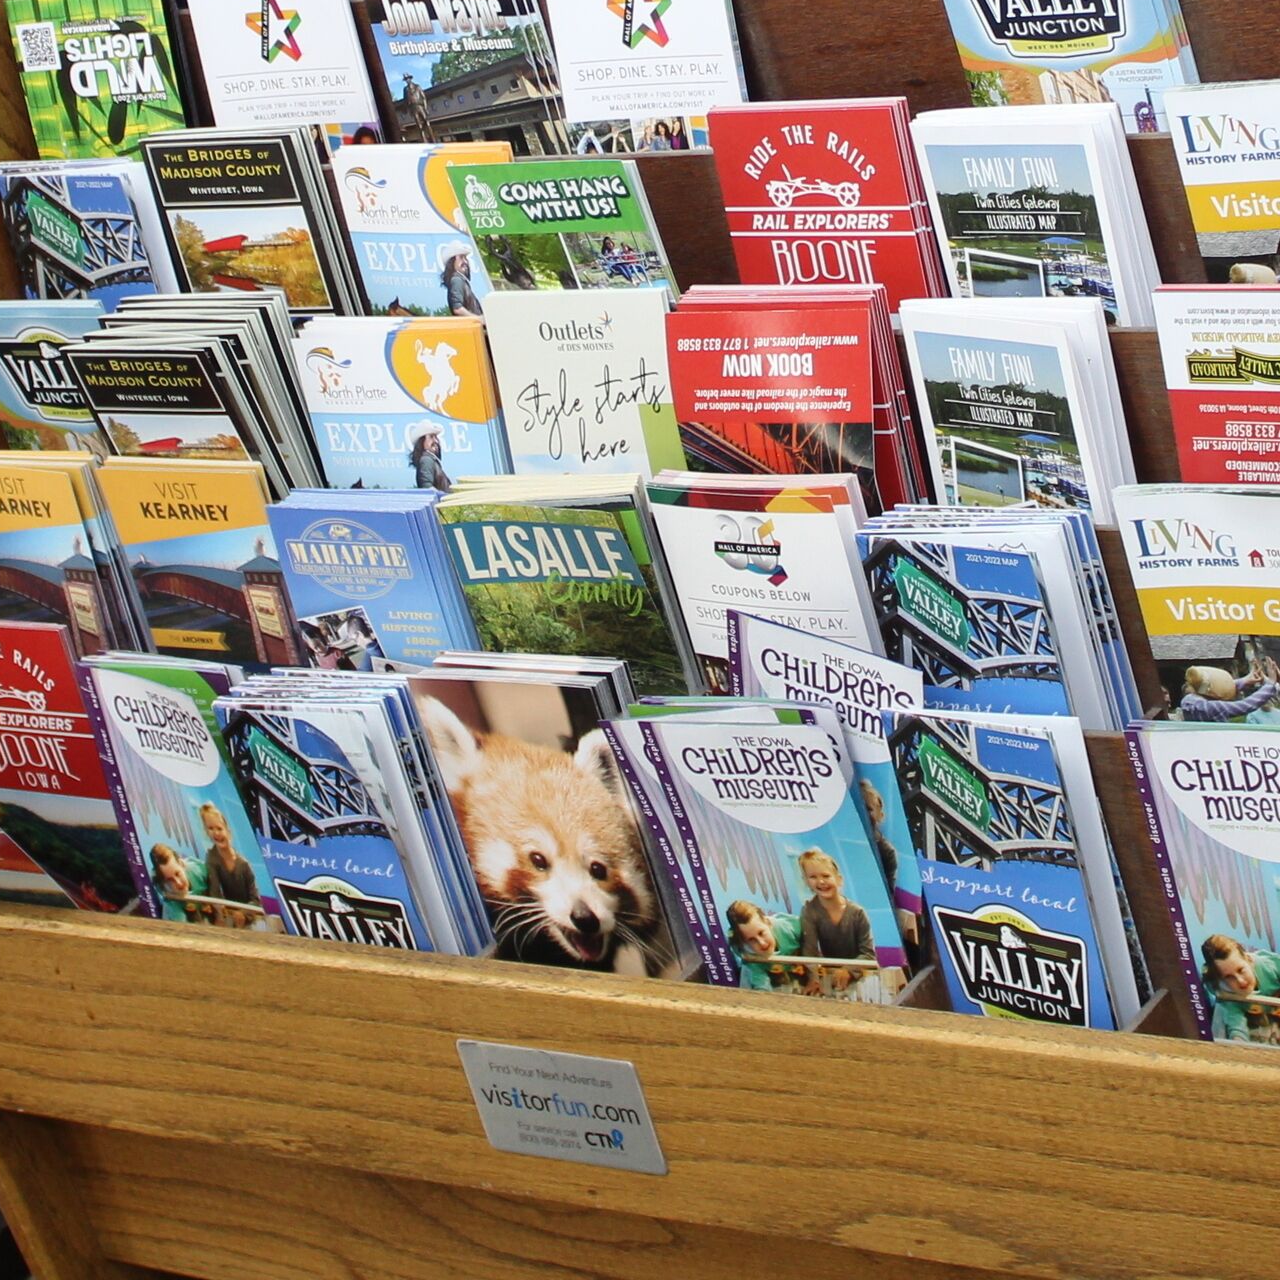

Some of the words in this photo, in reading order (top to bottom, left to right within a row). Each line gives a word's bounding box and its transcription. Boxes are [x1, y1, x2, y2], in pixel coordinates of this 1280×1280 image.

[1004, 18, 1105, 38] JUNCTION
[64, 32, 153, 62] LIGHTS
[389, 40, 449, 56] Birthplace
[451, 38, 461, 52] &
[463, 36, 514, 51] Museum
[70, 56, 165, 97] WILD
[743, 136, 778, 181] RIDE
[780, 124, 815, 146] THE
[826, 131, 876, 181] RAILS
[1186, 154, 1237, 166] HISTORY
[161, 165, 222, 180] MADISON
[226, 163, 281, 177] COUNTY
[189, 185, 241, 196] WINTERSET,
[242, 185, 264, 195] IOWA
[500, 181, 559, 204] COME
[560, 176, 628, 200] HANG
[752, 214, 789, 230] RAIL
[794, 213, 891, 230] EXPLORERS
[986, 215, 1035, 231] ILLUSTRATED
[1039, 214, 1057, 230] MAP
[539, 321, 604, 341] Outlets
[678, 338, 701, 351] 8588
[703, 338, 721, 349] 833
[723, 337, 741, 349] 877
[745, 337, 749, 349] 1
[754, 333, 858, 349] www.railexplorers.net
[86, 362, 106, 372] THE
[109, 360, 171, 373] BRIDGES
[176, 362, 188, 372] OF
[723, 353, 762, 377] NOW
[766, 352, 813, 377] BOOK
[85, 374, 144, 387] MADISON
[148, 374, 202, 388] COUNTY
[116, 392, 166, 403] WINTERSET,
[168, 394, 189, 403] IOWA
[322, 385, 354, 400] North
[356, 386, 387, 400] Platte
[516, 369, 583, 460] Style
[594, 357, 666, 423] starts
[694, 402, 708, 411] and
[709, 401, 740, 412] outdoors
[741, 401, 754, 411] the
[754, 402, 762, 411] of
[764, 402, 794, 412] freedom
[796, 402, 808, 411] the
[809, 400, 851, 412] Experience
[1226, 424, 1253, 436] 8588
[1255, 424, 1275, 437] 833
[580, 416, 630, 464] here
[1238, 471, 1280, 482] AVAILABLE
[154, 482, 198, 500] VISIT
[140, 502, 229, 522] KEARNEY
[1129, 518, 1236, 558] LIVING
[289, 542, 408, 569] MAHAFFIE
[453, 523, 633, 582] LASALLE
[718, 543, 735, 553] MALL
[736, 544, 746, 553] OF
[747, 545, 778, 555] AMERICA
[966, 554, 1002, 566] 2021-2022
[1002, 557, 1019, 567] MAP
[1139, 559, 1193, 569] HISTORY
[1197, 558, 1240, 567] FARMS
[544, 569, 645, 616] County
[712, 584, 766, 601] COUPONS
[770, 590, 811, 602] BELOW
[388, 610, 433, 621] LIVING
[182, 635, 214, 646] ARCHWAY
[823, 653, 845, 669] THE
[848, 661, 884, 682] IOWA
[0, 714, 74, 732] EXPLORERS
[731, 736, 756, 748] THE
[758, 736, 793, 748] IOWA
[1128, 740, 1144, 780] explore
[1235, 746, 1260, 759] THE
[17, 770, 61, 790] IOWA
[925, 751, 983, 815] VALLEY
[933, 755, 975, 793] HISTORIC
[711, 777, 816, 804] museum
[1142, 802, 1162, 844] discover
[921, 866, 1014, 898] Support
[1019, 887, 1077, 913] local
[1162, 866, 1175, 899] create
[1172, 920, 1190, 962] imagine
[950, 931, 1082, 1010] VALLEY
[1190, 983, 1206, 1022] explore
[488, 1062, 511, 1075] Find
[511, 1066, 534, 1078] Your
[536, 1068, 561, 1081] Next
[562, 1072, 613, 1089] Adventure
[481, 1083, 641, 1126] visitorfun.com
